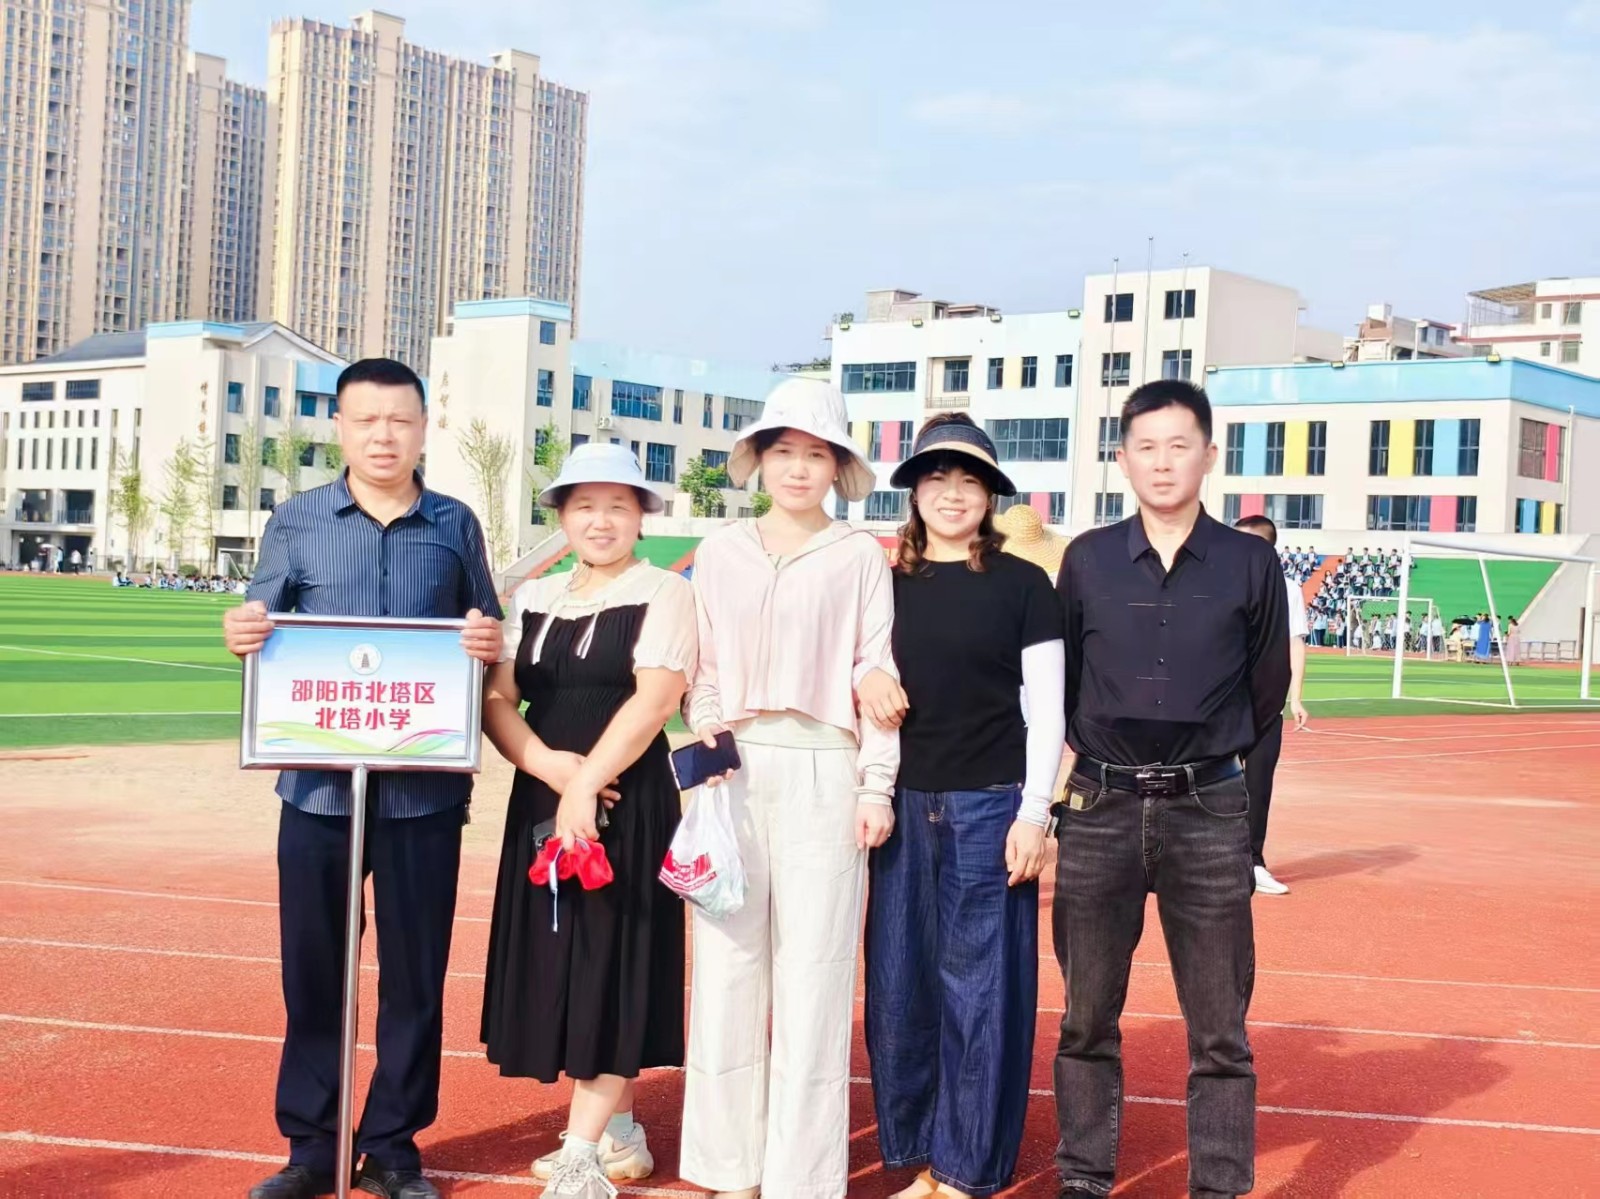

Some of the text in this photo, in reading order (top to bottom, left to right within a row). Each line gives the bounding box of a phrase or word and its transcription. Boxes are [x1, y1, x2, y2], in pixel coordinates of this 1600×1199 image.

[291, 680, 436, 704] 邵阳市北塔区
[315, 707, 411, 730] 北塔小学
